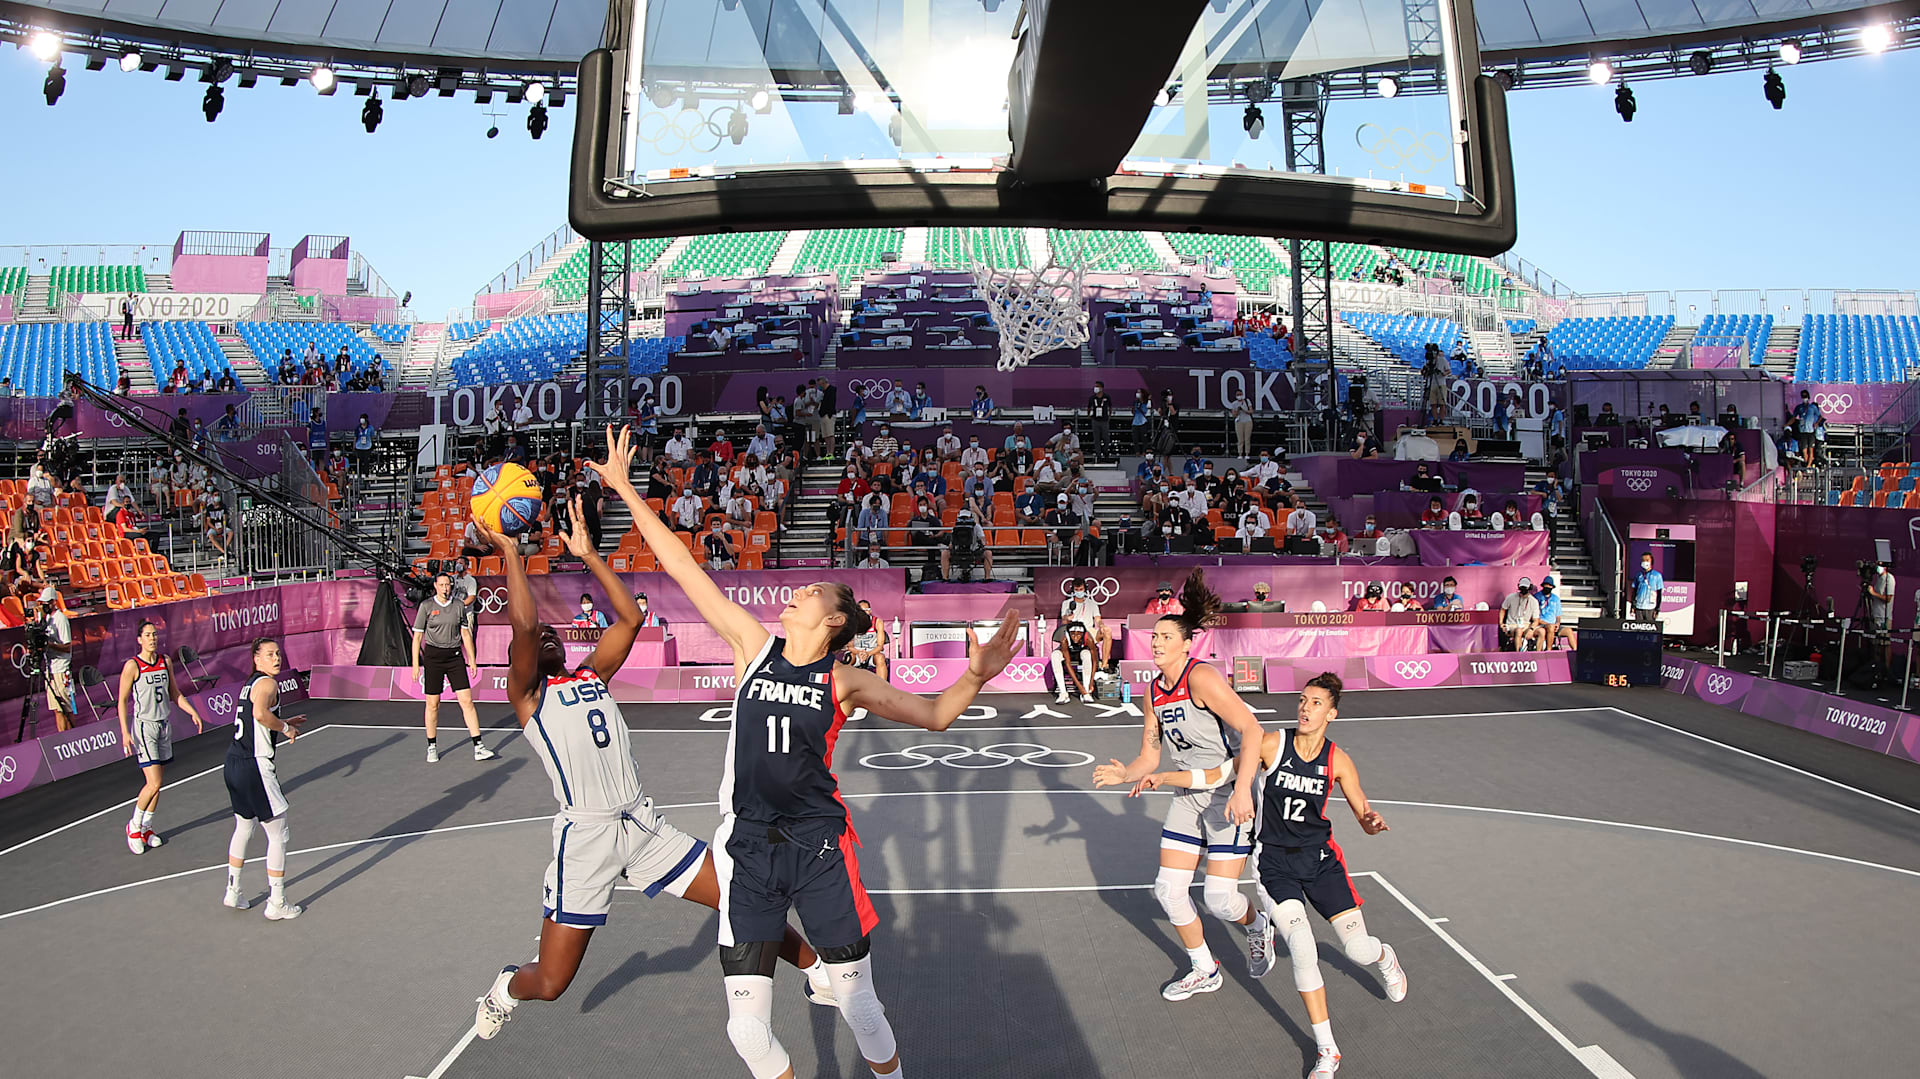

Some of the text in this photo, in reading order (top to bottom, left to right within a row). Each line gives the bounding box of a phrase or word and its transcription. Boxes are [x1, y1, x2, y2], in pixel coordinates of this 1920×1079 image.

[179, 297, 229, 316] 2020
[1452, 379, 1550, 420] 2020
[257, 443, 277, 455] S09
[725, 586, 793, 605] TOKYO
[212, 602, 279, 632] TOKYO 2020
[1294, 614, 1354, 625] TOKYO 2020
[1416, 612, 1470, 623] TOKYO 2020
[1630, 623, 1657, 631] OMEGA
[565, 630, 600, 640] TOKYO
[146, 673, 168, 684] USA
[1470, 660, 1538, 674] TOKYO 2020
[1665, 665, 1685, 680] 2020
[154, 686, 163, 703] 5
[557, 681, 612, 706] USA
[746, 677, 825, 711] FRANCE
[234, 705, 244, 740] 5
[587, 708, 611, 749] 8
[1825, 706, 1887, 735] TOKYO 2020
[54, 730, 117, 761] TOKYO 2020
[766, 715, 791, 754] 11
[1165, 727, 1193, 752] 13
[1275, 770, 1325, 795] FRANCE
[1283, 796, 1307, 822] 12
